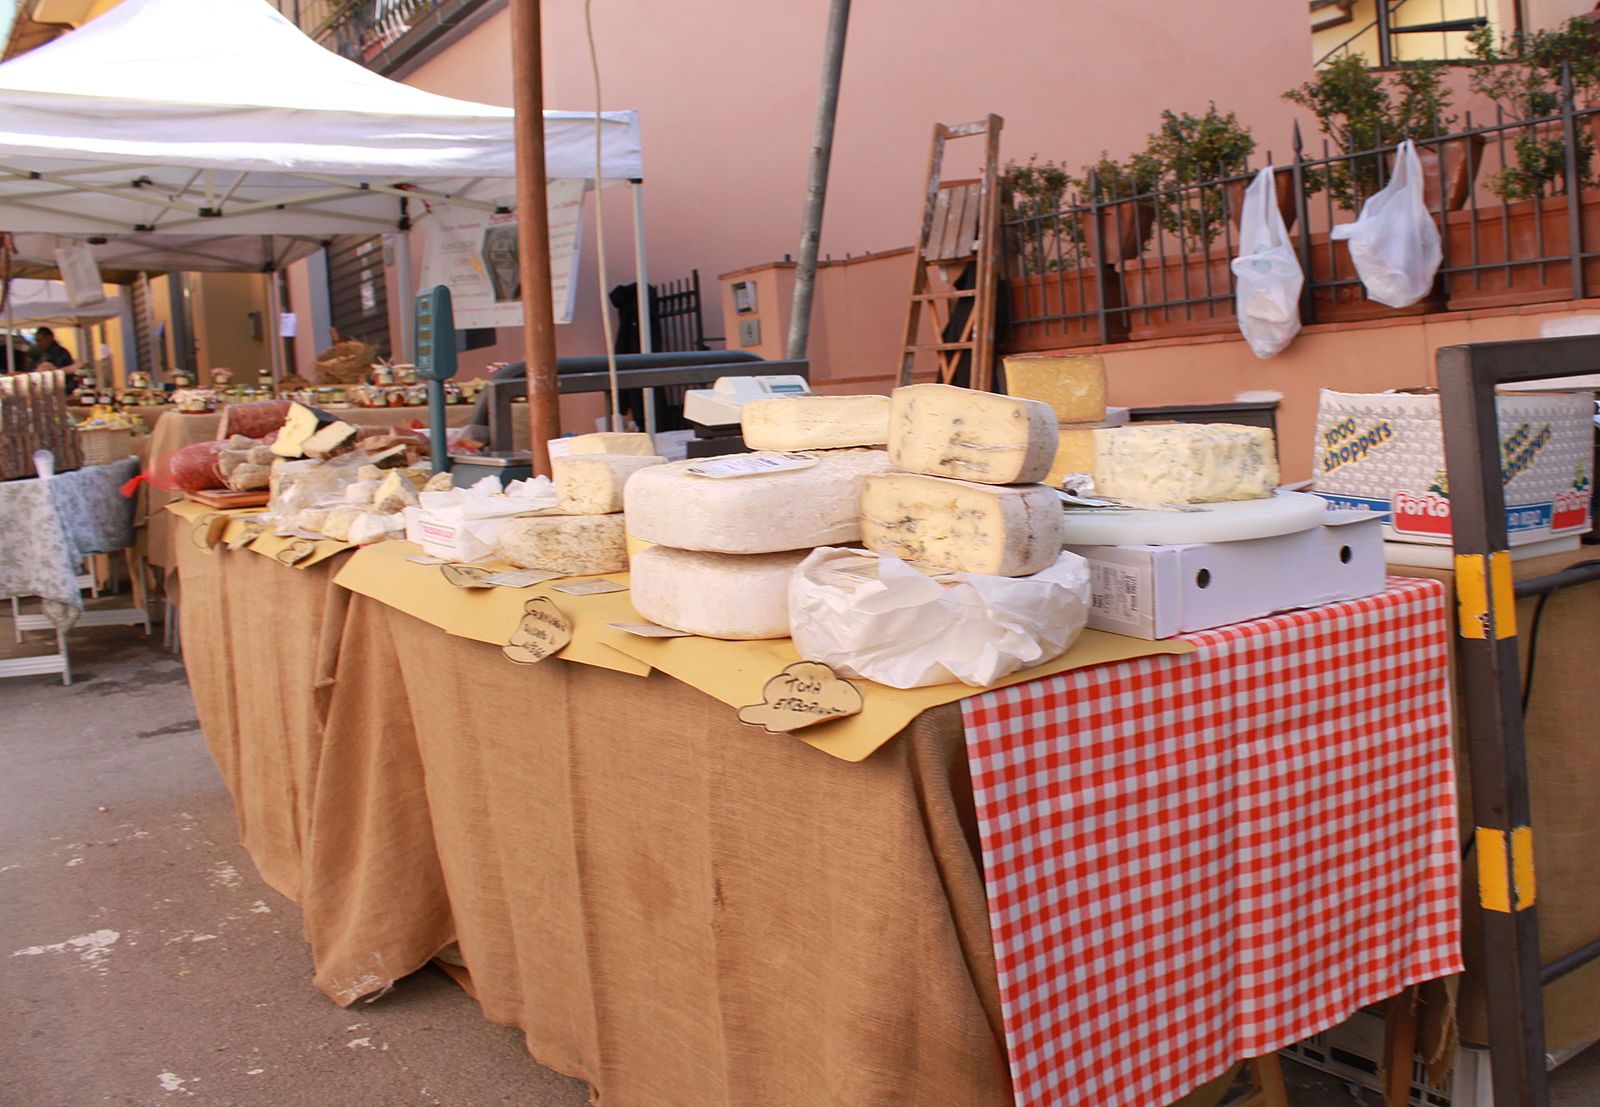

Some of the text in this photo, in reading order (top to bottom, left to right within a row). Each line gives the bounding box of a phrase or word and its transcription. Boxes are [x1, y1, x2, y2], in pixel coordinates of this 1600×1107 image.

[1323, 418, 1356, 448] 1000
[1323, 421, 1392, 473] shoppers
[785, 678, 821, 694] TOMA
